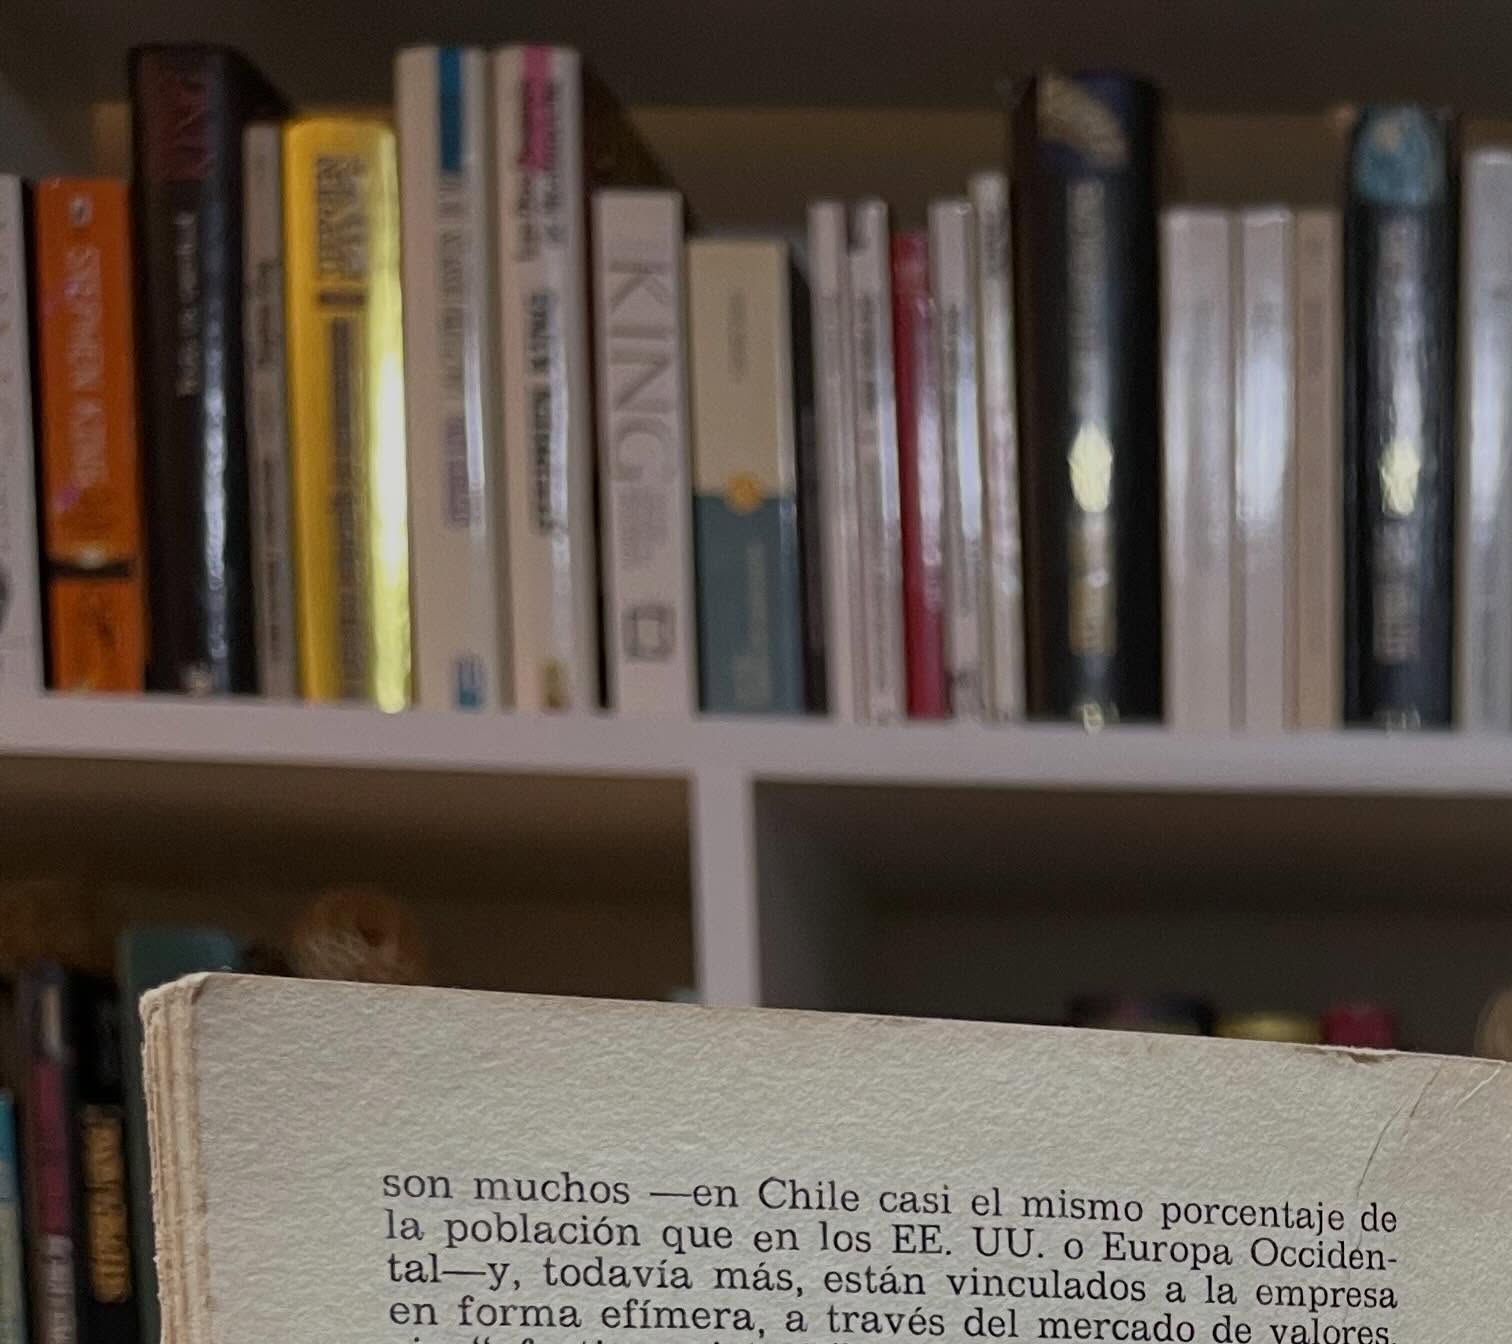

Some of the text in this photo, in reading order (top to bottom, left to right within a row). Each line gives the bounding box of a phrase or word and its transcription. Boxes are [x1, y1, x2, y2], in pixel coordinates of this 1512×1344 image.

[606, 256, 679, 484] KING
[382, 1174, 454, 1200] son
[473, 1171, 631, 1206] muchos
[758, 1176, 860, 1213] Chile
[878, 1183, 953, 1215] casi
[971, 1186, 1003, 1217] el
[1020, 1188, 1144, 1223] mismo
[1160, 1200, 1345, 1237] porcentaje
[1360, 1201, 1397, 1233] de
